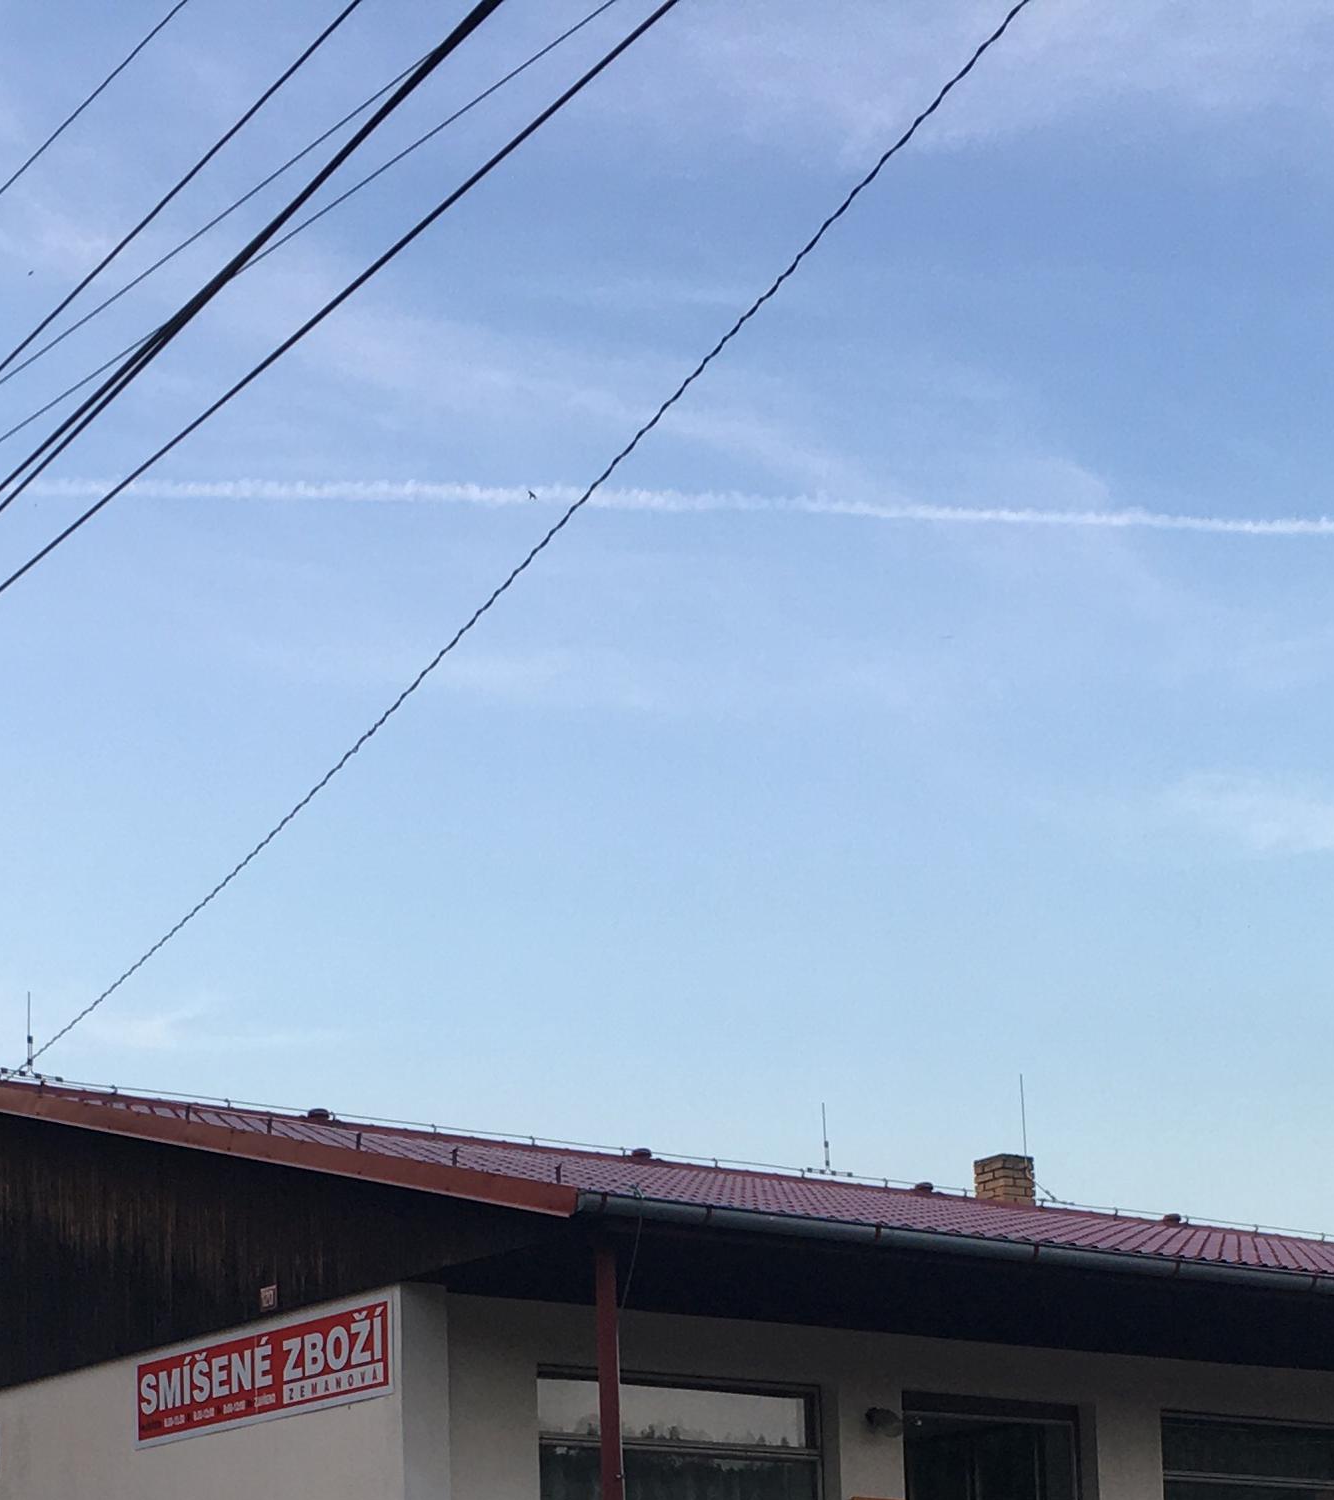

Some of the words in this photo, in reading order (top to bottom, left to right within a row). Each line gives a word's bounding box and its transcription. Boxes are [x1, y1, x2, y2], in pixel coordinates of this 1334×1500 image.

[140, 1336, 272, 1415] SMÍŠENÉ
[283, 1306, 385, 1382] ZBOŽÍ
[288, 1367, 380, 1401] ZEMANOVA
